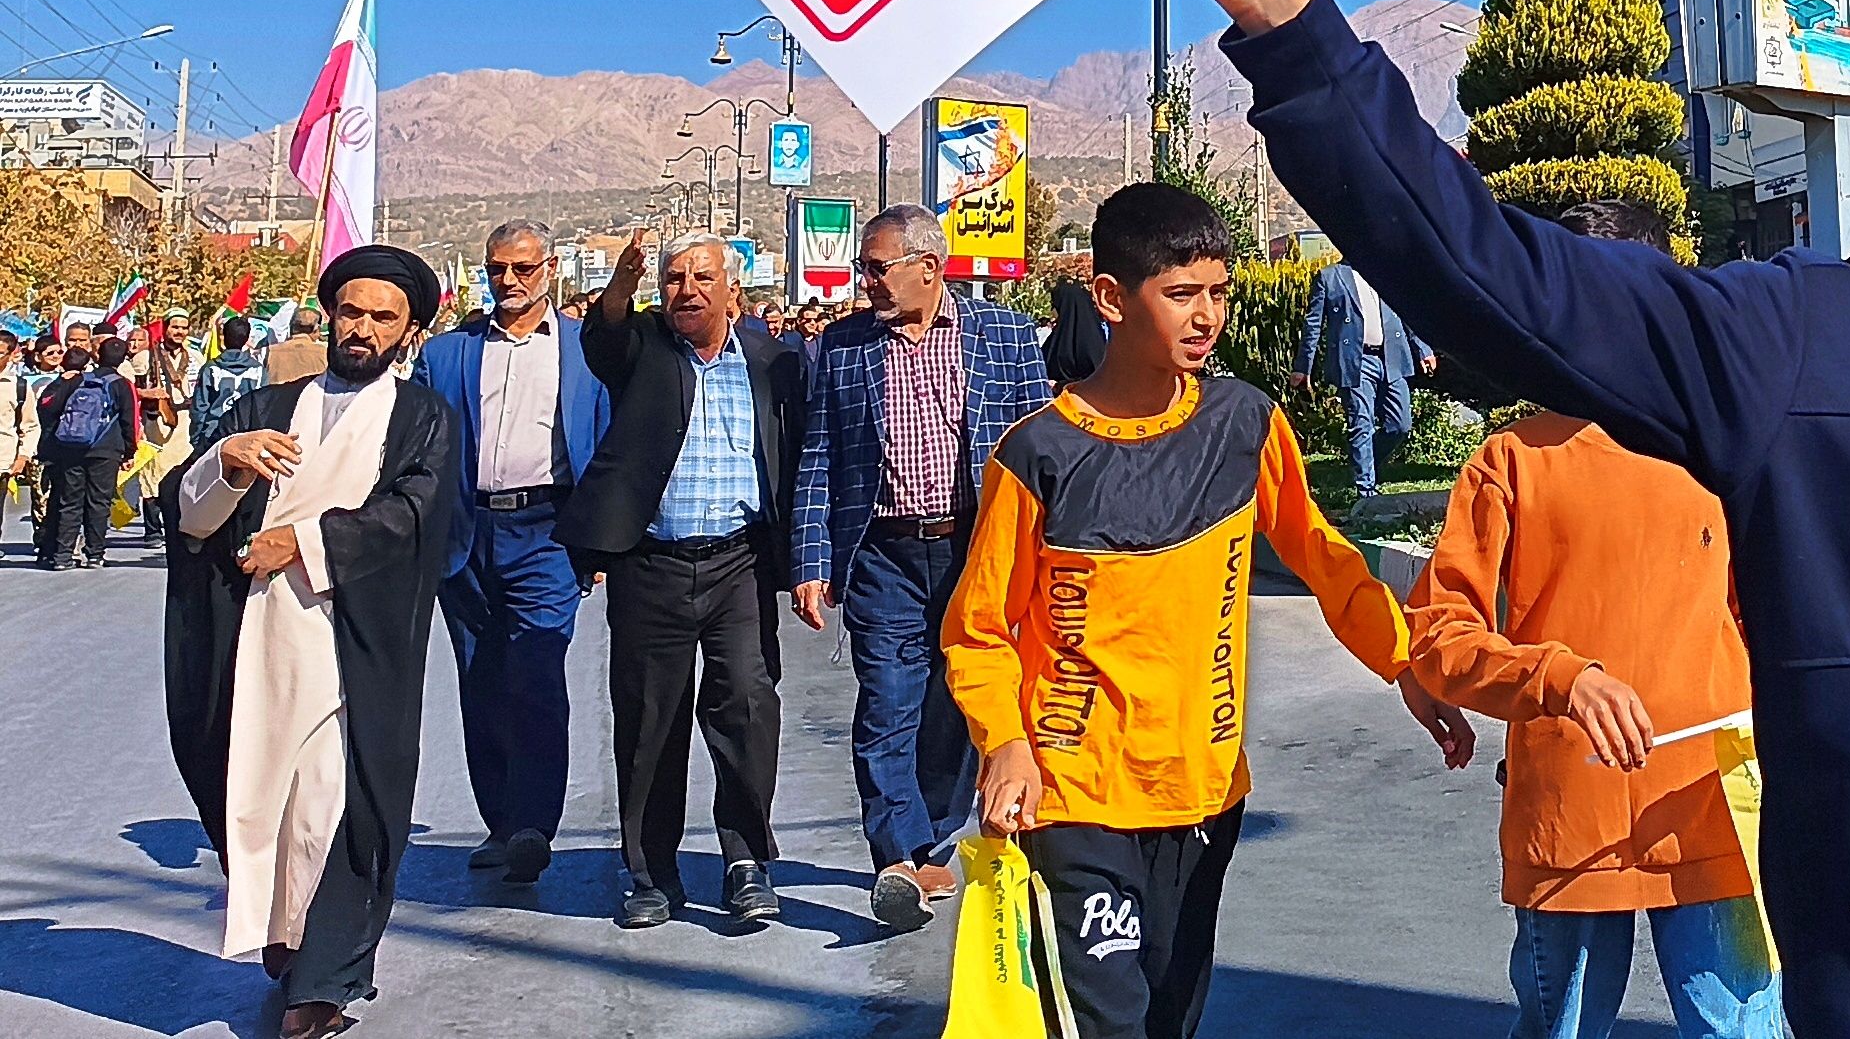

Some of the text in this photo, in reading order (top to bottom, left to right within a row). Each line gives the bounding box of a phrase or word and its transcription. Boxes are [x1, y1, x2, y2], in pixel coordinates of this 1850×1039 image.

[49, 87, 73, 97] بانک
[957, 188, 1015, 217] مرگ بر
[956, 210, 1015, 238] اسرائیل
[1078, 892, 1141, 939] Polo
